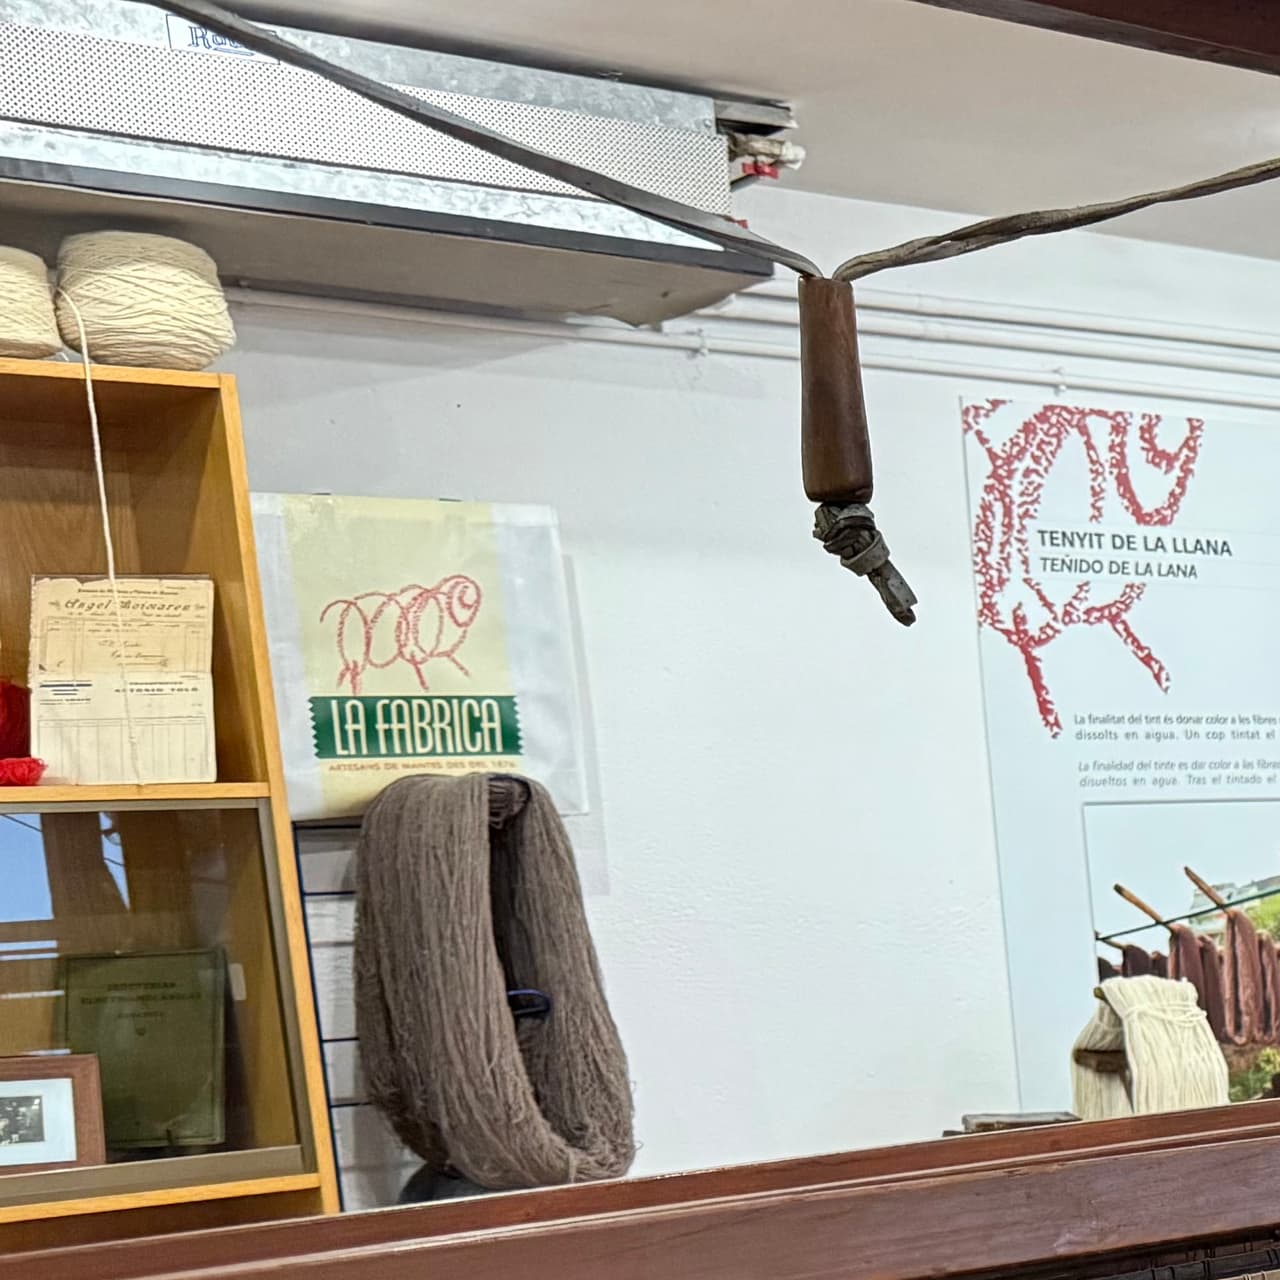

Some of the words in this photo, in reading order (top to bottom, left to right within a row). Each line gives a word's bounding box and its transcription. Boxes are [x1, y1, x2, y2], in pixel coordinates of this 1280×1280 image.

[1037, 529, 1105, 549] TENYIT
[1112, 534, 1137, 551] DE
[1143, 536, 1167, 553] LA
[1173, 537, 1233, 557] LLANA
[1040, 554, 1104, 575] TEÑIDO
[1108, 560, 1131, 576] DE
[1135, 561, 1154, 577] LA
[1157, 563, 1198, 579] LANA
[331, 699, 368, 755] LA
[375, 698, 504, 755] FABRICA
[1128, 713, 1142, 725] del
[1205, 713, 1229, 725] color
[1075, 729, 1119, 741] dissolts
[1124, 731, 1139, 741] en
[1185, 730, 1200, 740] Un
[1206, 731, 1225, 742] cop
[1231, 730, 1261, 741] tintat
[1266, 729, 1276, 740] el
